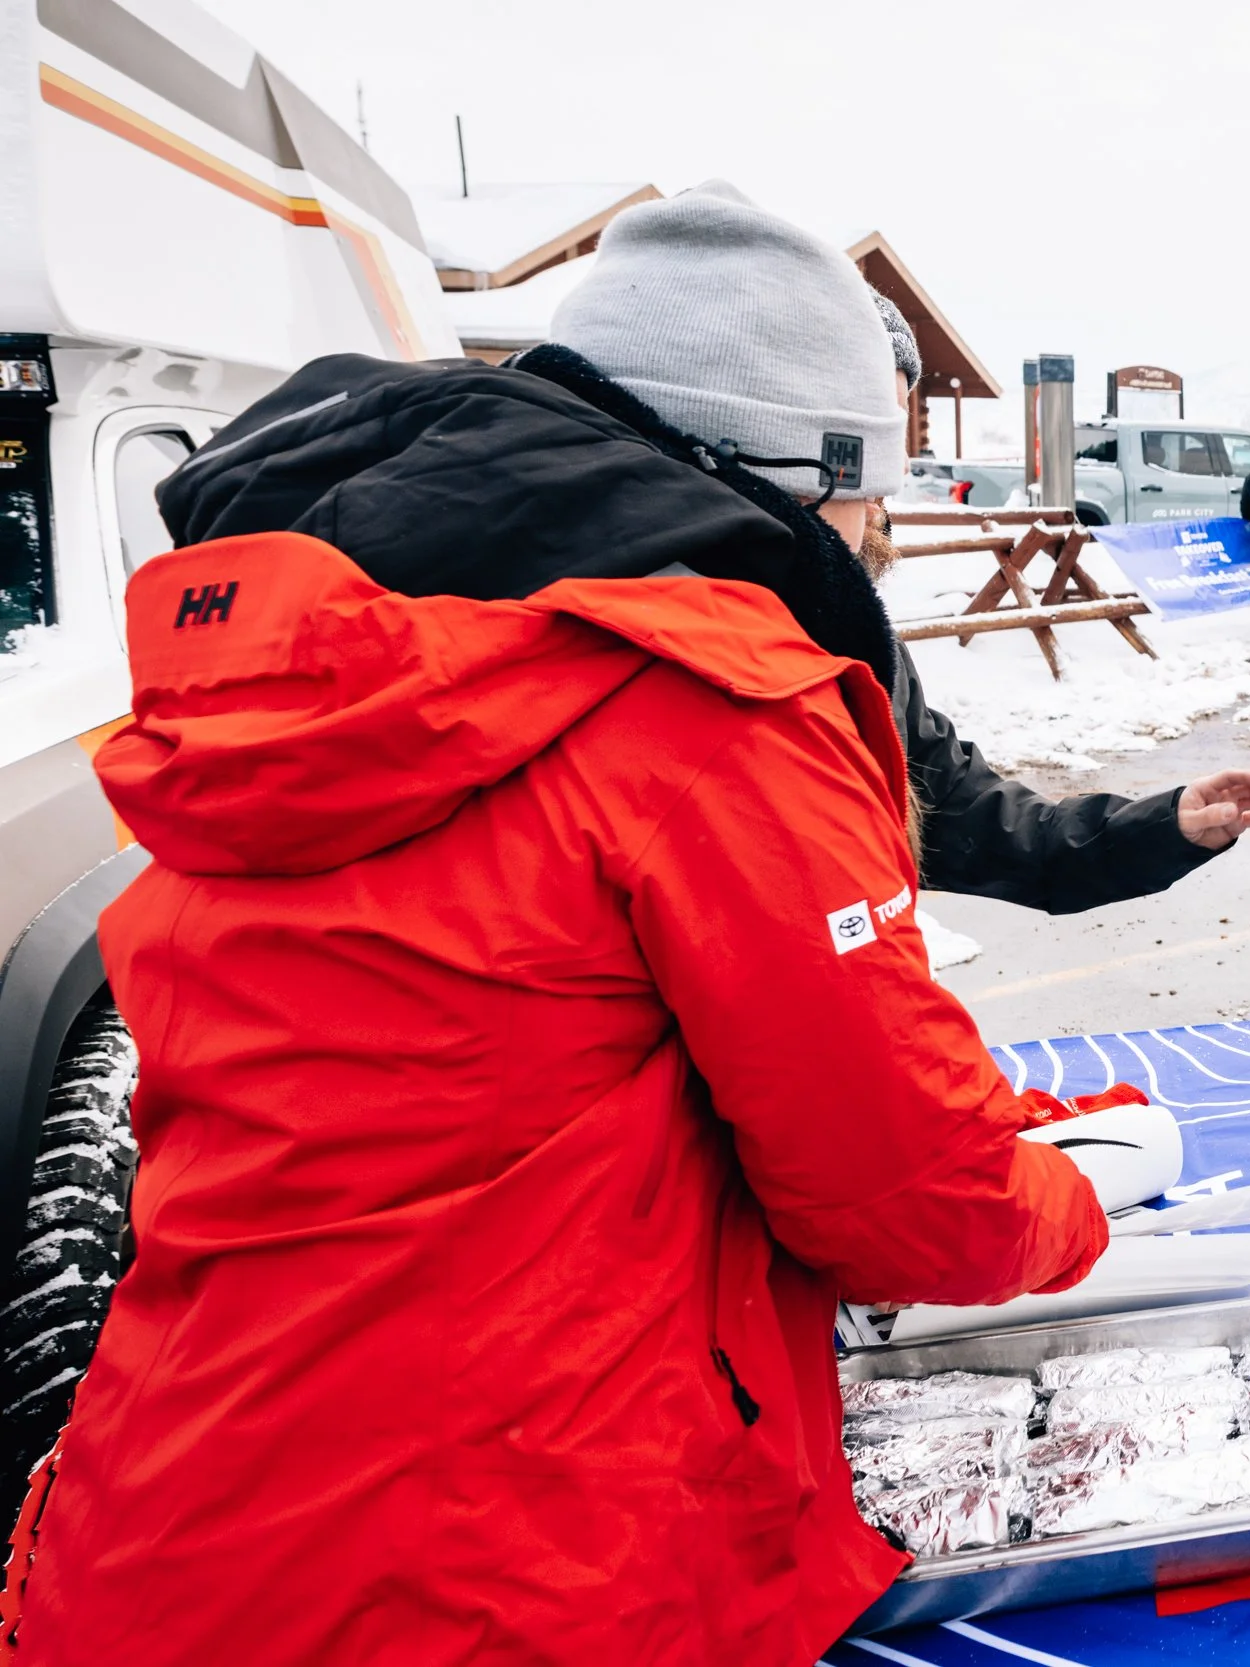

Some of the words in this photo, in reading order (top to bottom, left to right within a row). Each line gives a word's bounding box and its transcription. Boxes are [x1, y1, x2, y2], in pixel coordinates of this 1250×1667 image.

[1169, 509, 1191, 517] PARK
[1194, 509, 1214, 517] CITY
[1174, 541, 1225, 556] TAKEOVER
[1145, 577, 1185, 591] Free
[174, 581, 240, 629] HH
